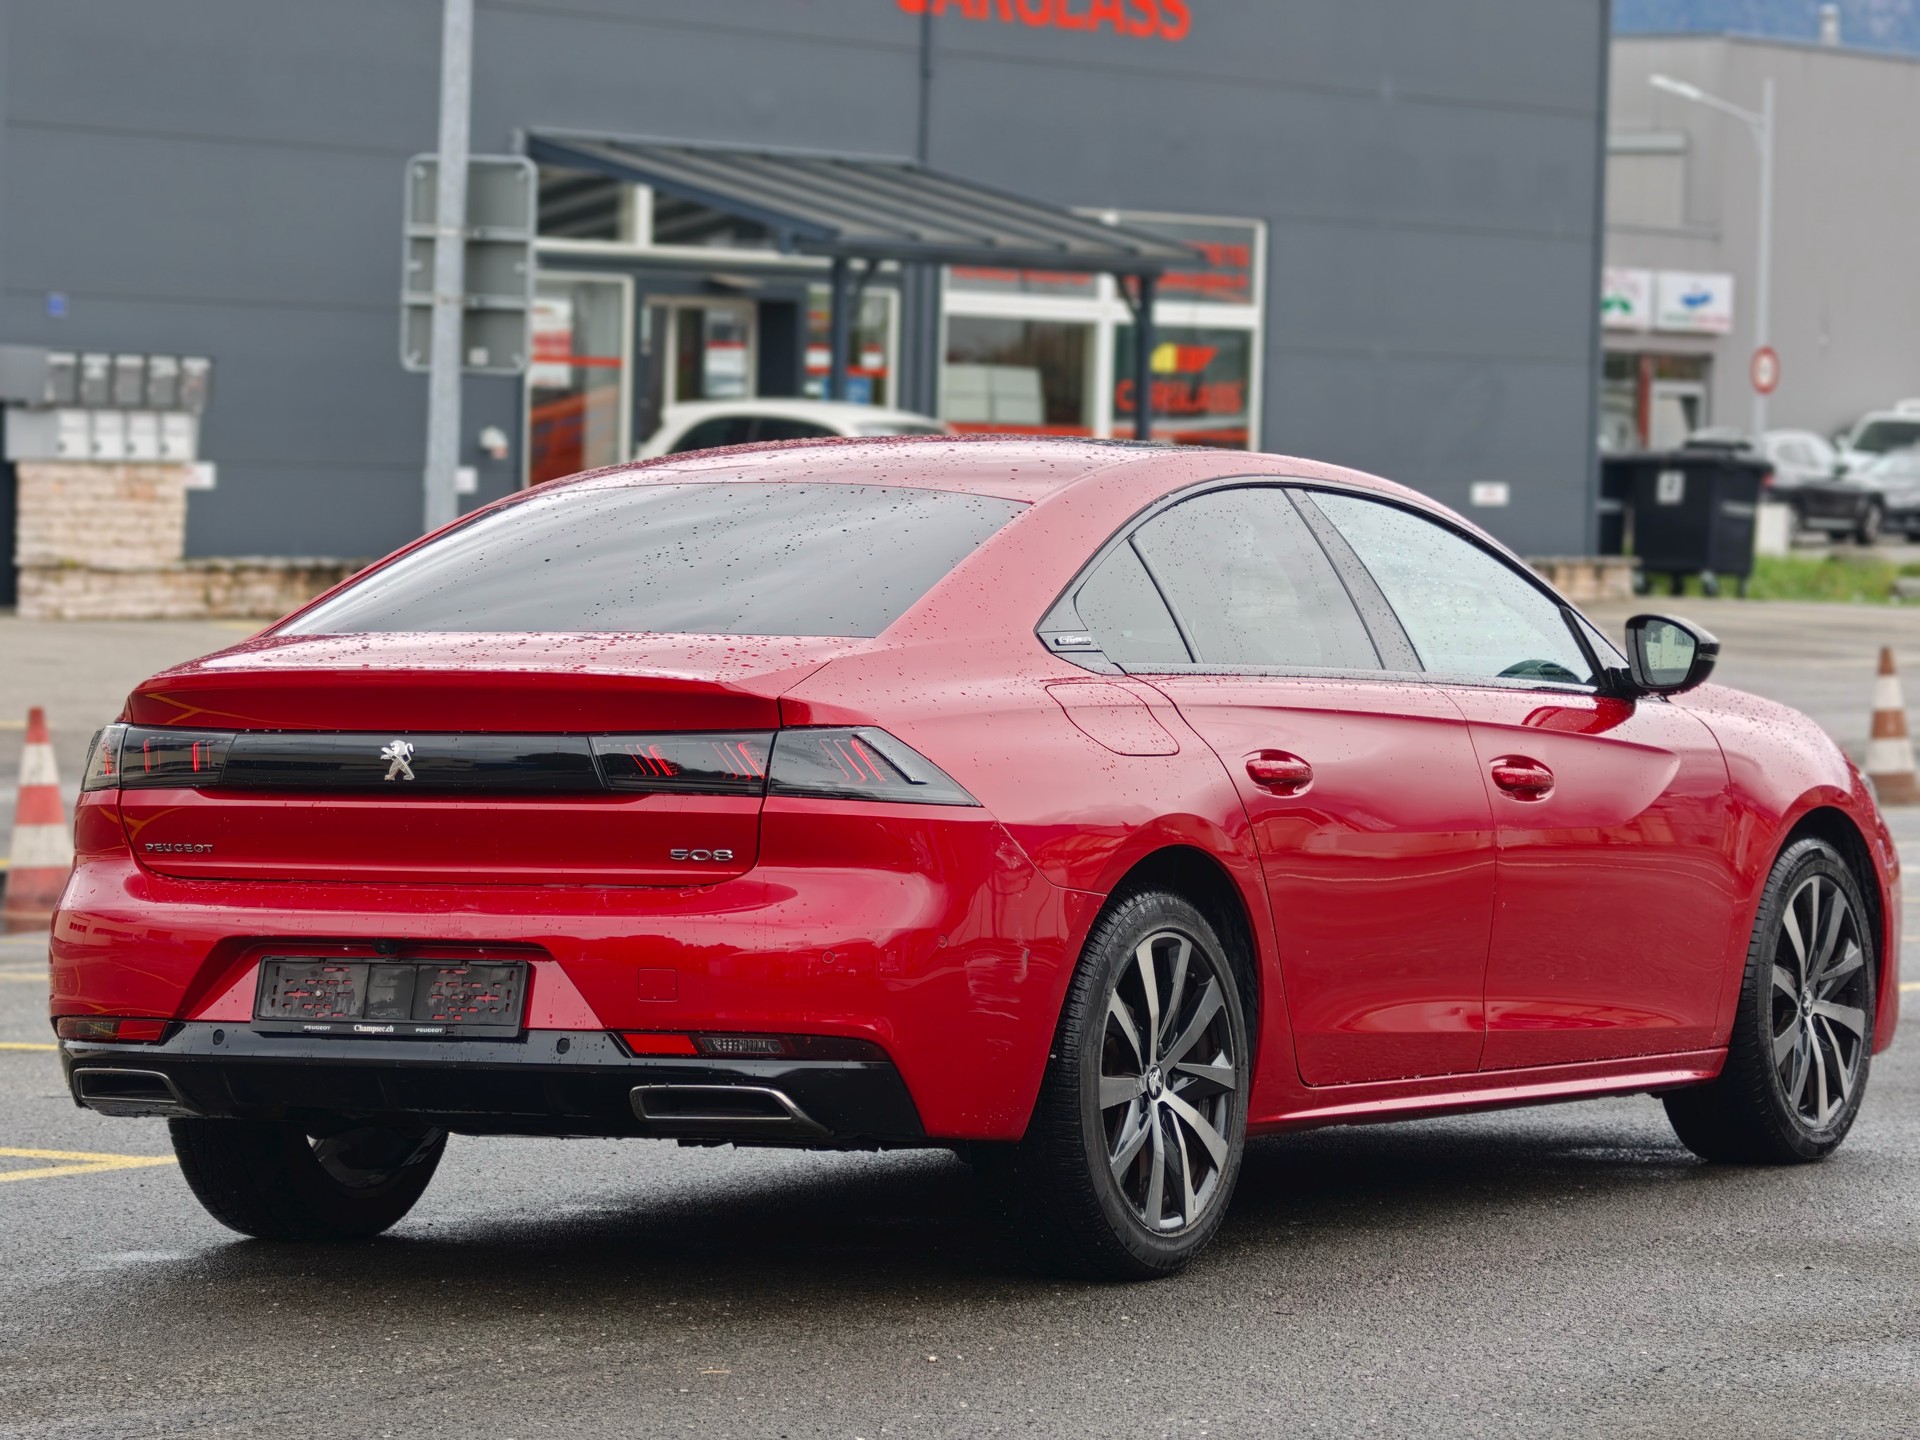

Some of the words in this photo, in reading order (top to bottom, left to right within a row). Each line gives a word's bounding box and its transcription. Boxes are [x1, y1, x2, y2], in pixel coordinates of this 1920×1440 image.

[896, 0, 1191, 41] LASS
[1116, 379, 1243, 415] CRGLASS
[145, 843, 213, 853] PEUGEOT
[670, 849, 734, 861] 508
[353, 1024, 394, 1034] Champsec.ch
